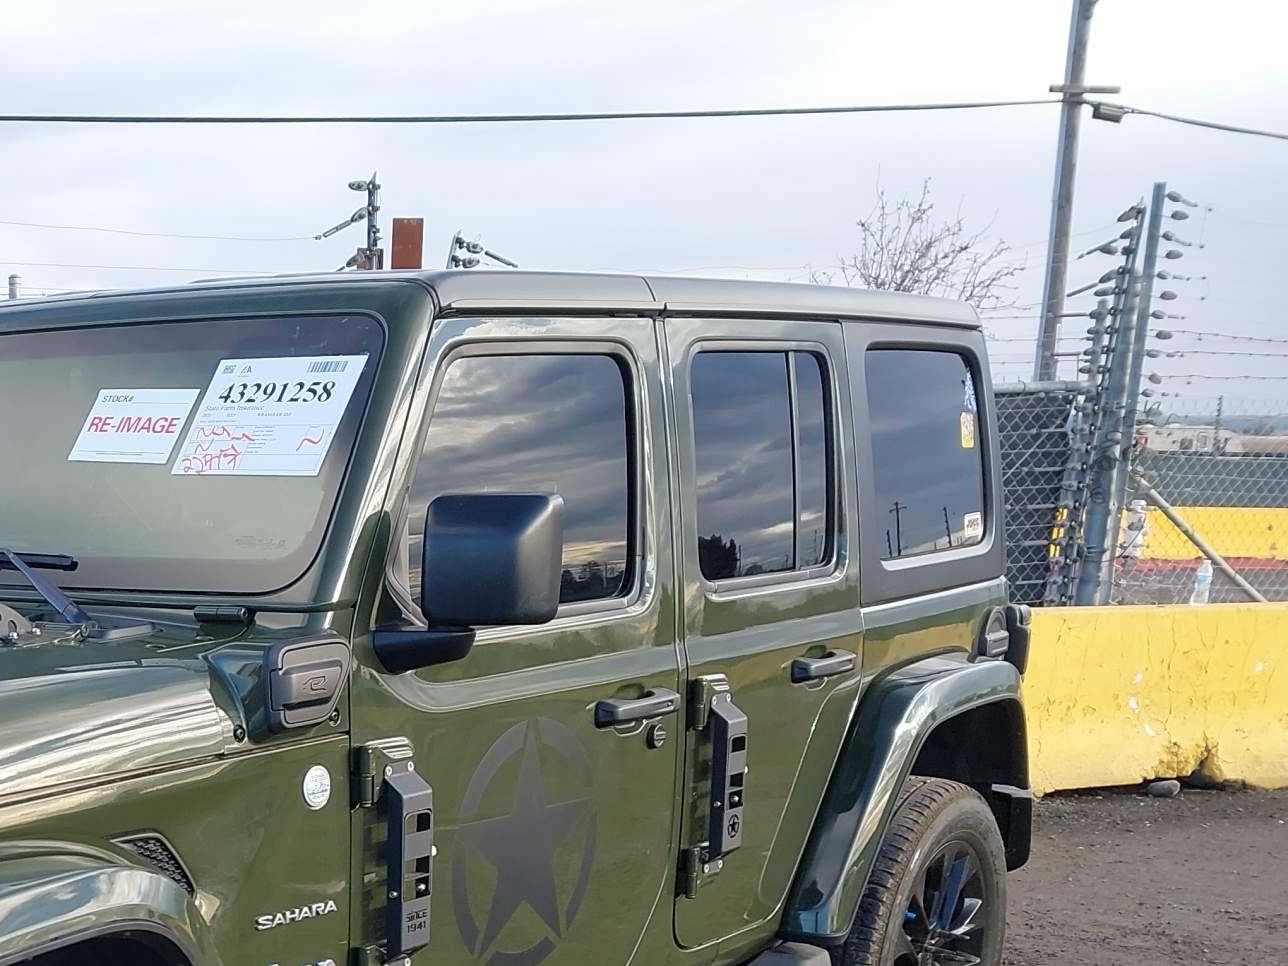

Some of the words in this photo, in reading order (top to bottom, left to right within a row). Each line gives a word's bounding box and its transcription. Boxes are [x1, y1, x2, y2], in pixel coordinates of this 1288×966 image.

[101, 395, 135, 403] STOCK#
[218, 381, 336, 404] 43291258
[86, 415, 181, 434] RE-IMAGE
[255, 900, 338, 931] SAHARA
[407, 920, 427, 934] 1941
